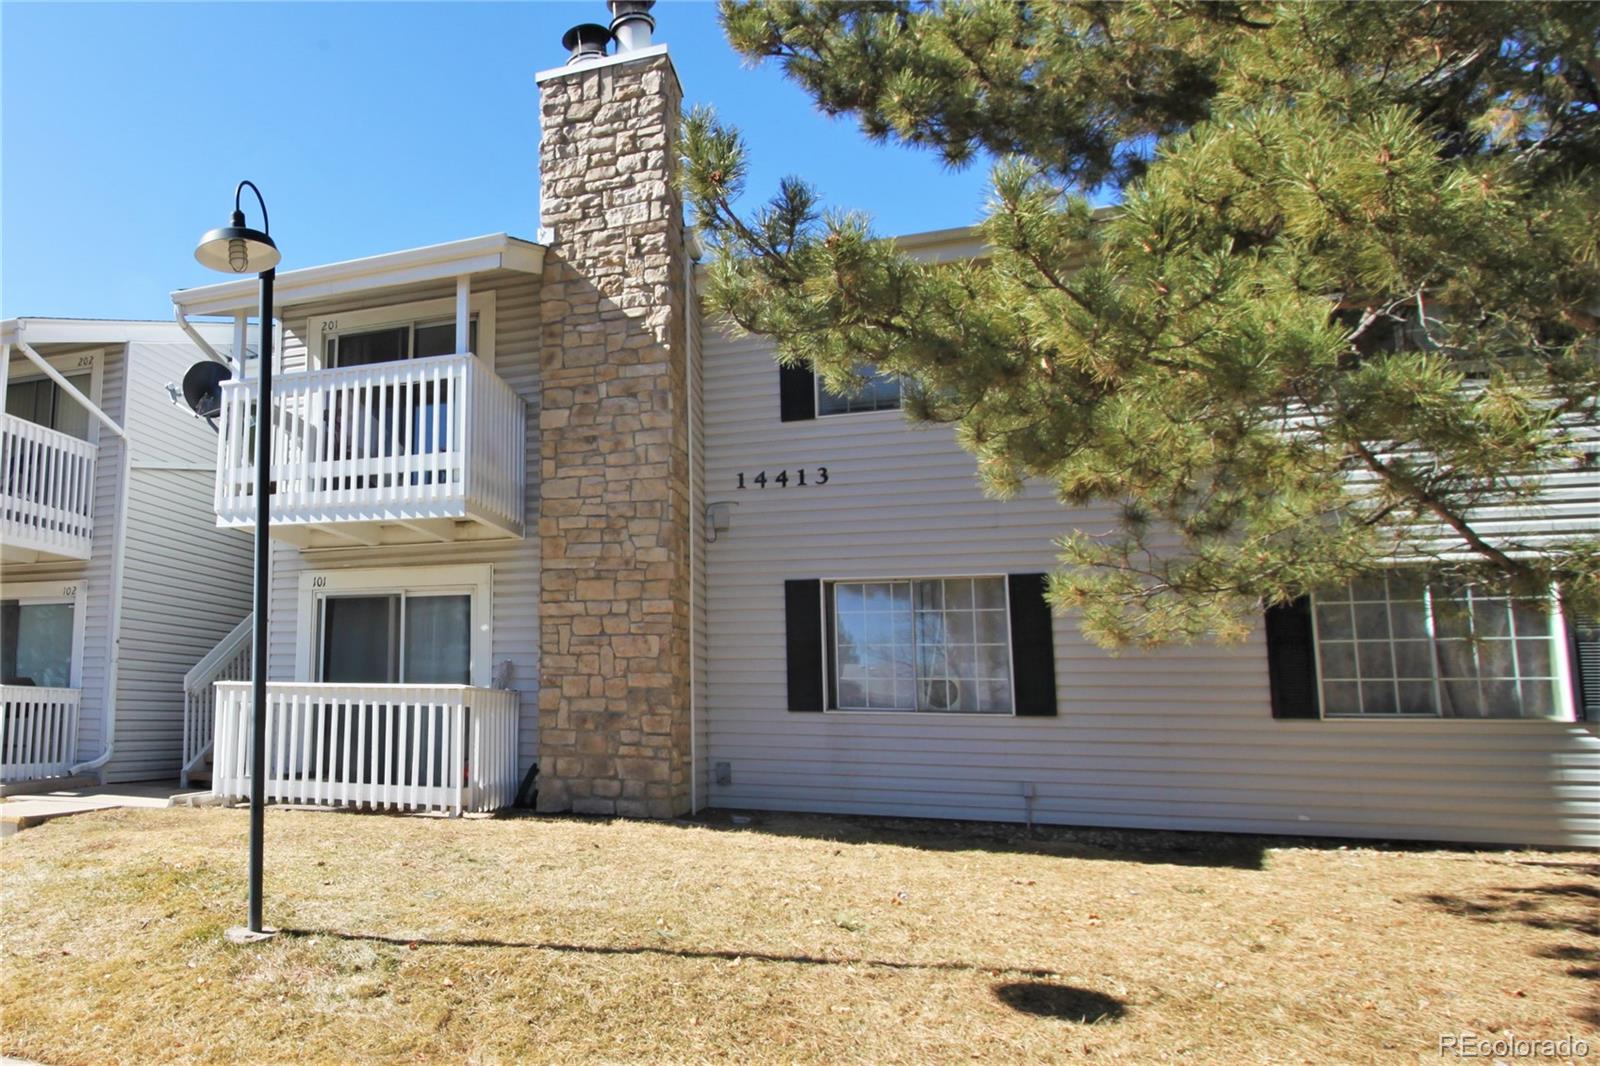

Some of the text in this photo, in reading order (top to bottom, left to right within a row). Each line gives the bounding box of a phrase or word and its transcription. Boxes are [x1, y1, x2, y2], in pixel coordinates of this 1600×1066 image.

[321, 319, 338, 331] 201
[736, 467, 829, 489] 14413
[312, 576, 327, 588] 101
[63, 585, 77, 596] 102
